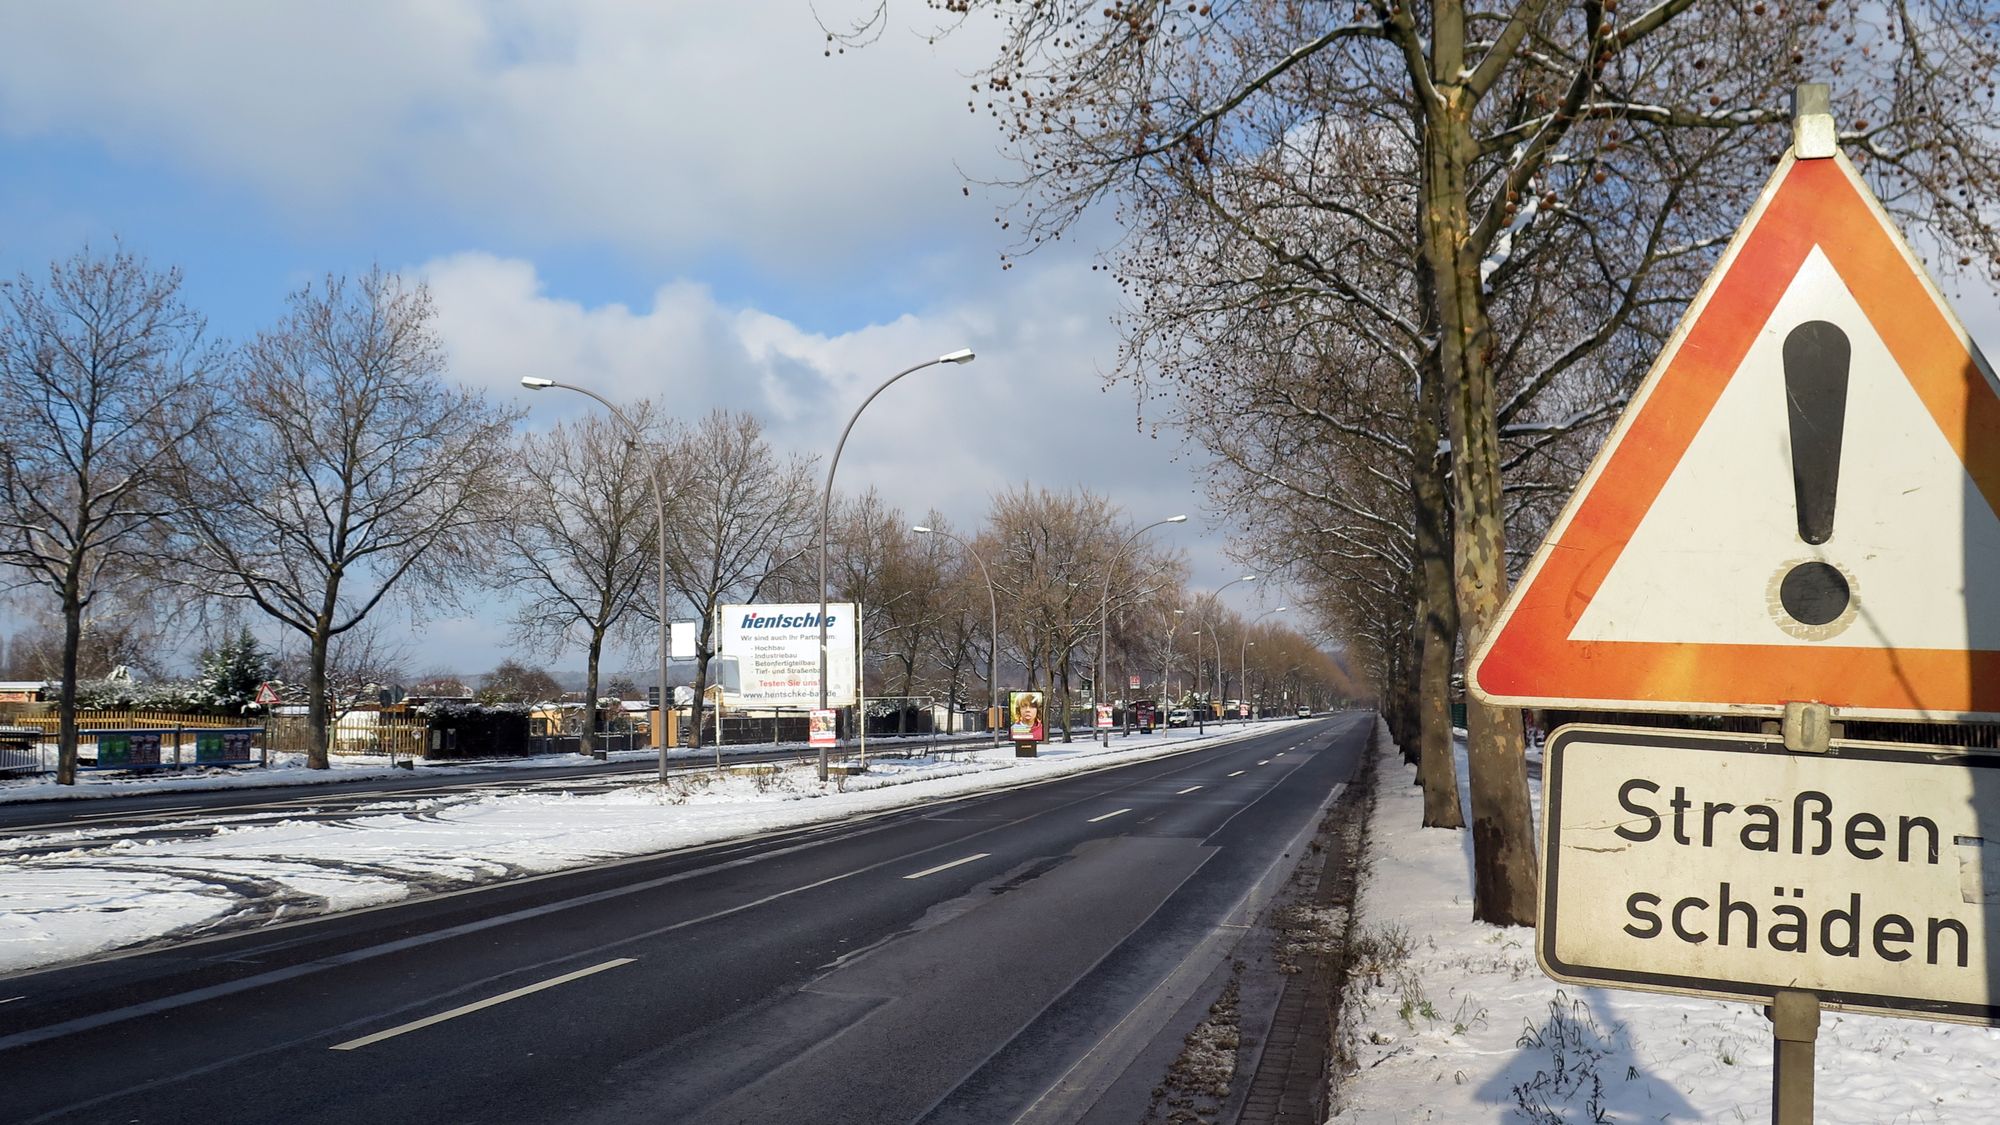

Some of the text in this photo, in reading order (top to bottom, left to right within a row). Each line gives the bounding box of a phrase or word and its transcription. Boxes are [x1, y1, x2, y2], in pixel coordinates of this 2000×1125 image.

[755, 660, 815, 668] Betonfertigteilbau
[1613, 777, 1985, 866] Straßen-
[1622, 881, 1970, 969] schäden
